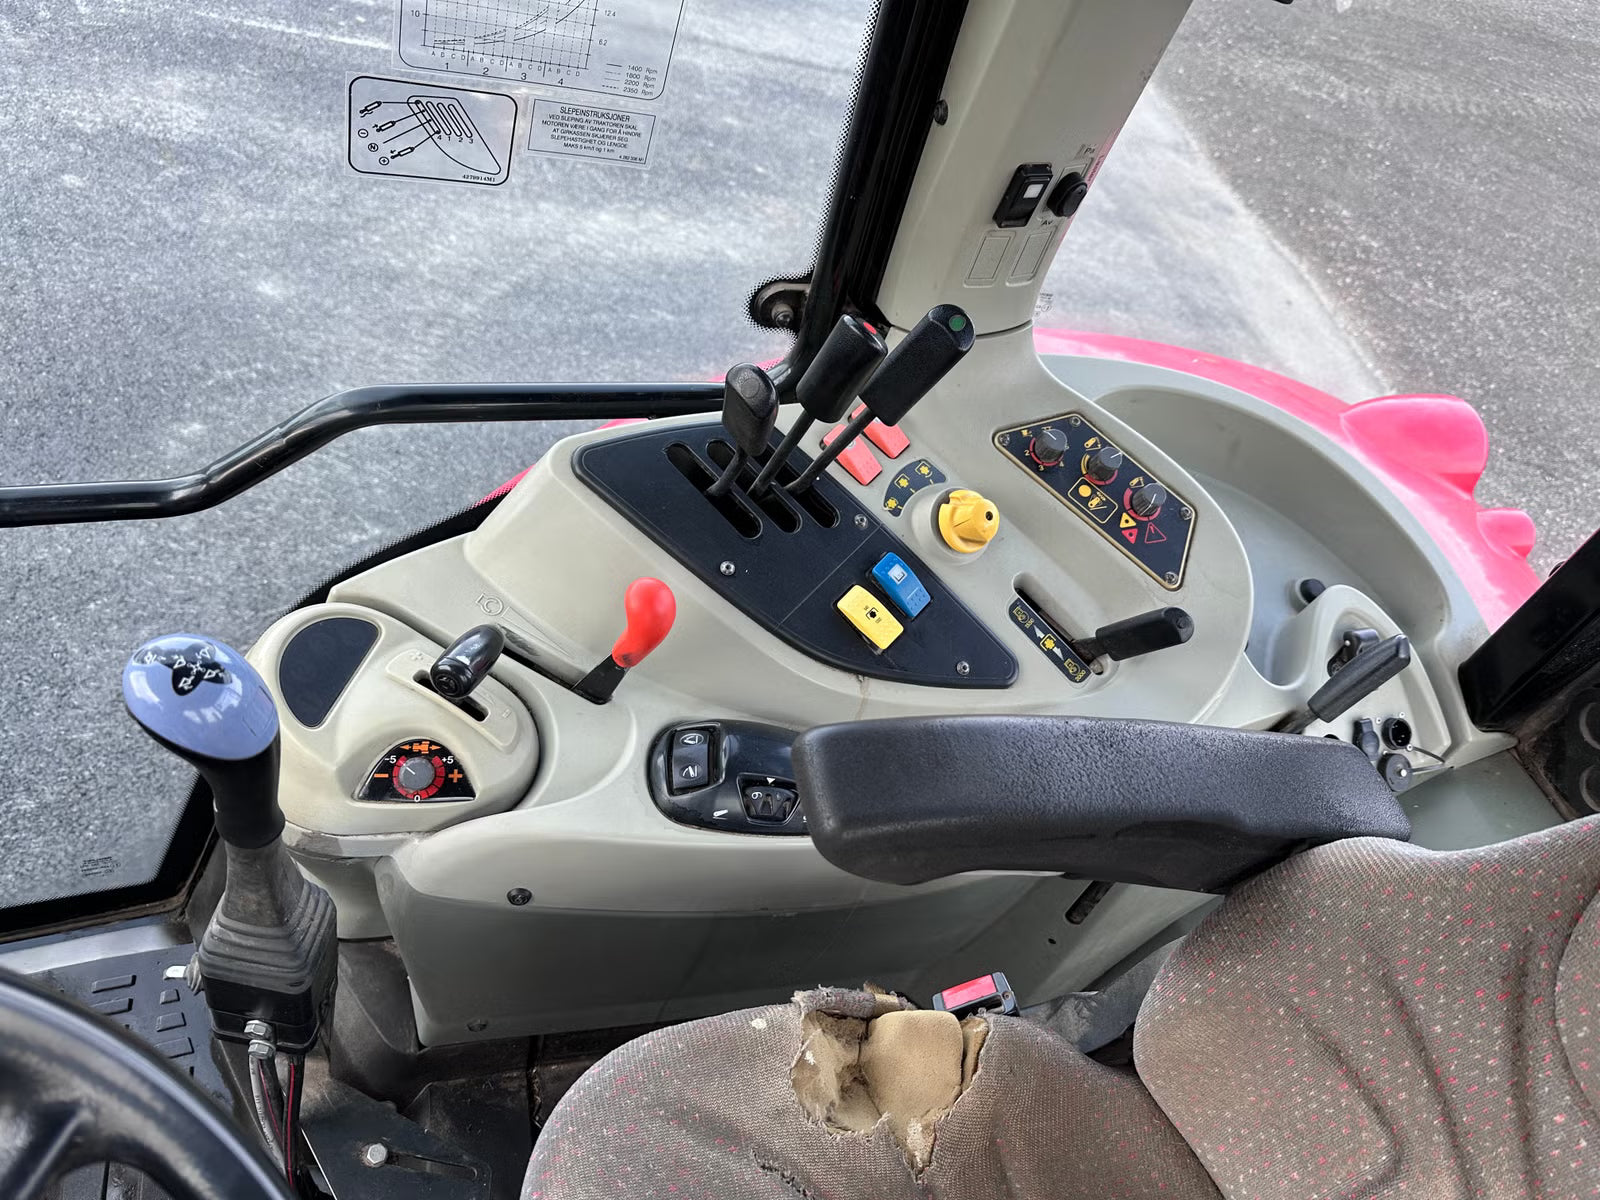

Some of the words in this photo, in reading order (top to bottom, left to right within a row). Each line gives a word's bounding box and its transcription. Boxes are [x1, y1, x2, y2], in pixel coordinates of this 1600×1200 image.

[628, 65, 643, 73] 1400
[482, 67, 489, 76] 2
[520, 73, 527, 81] 3
[557, 78, 564, 86] 4
[624, 79, 640, 87] 2200
[559, 106, 630, 122] SLEPEINSTRUKSJONER
[541, 120, 569, 128] MOTOREN
[560, 115, 584, 123] SLEPING
[592, 119, 624, 129] TRAKTOREN
[560, 129, 591, 138] GIRKASSEN
[550, 134, 597, 145] SLEPEHASTIGHET
[413, 794, 421, 802] 0
